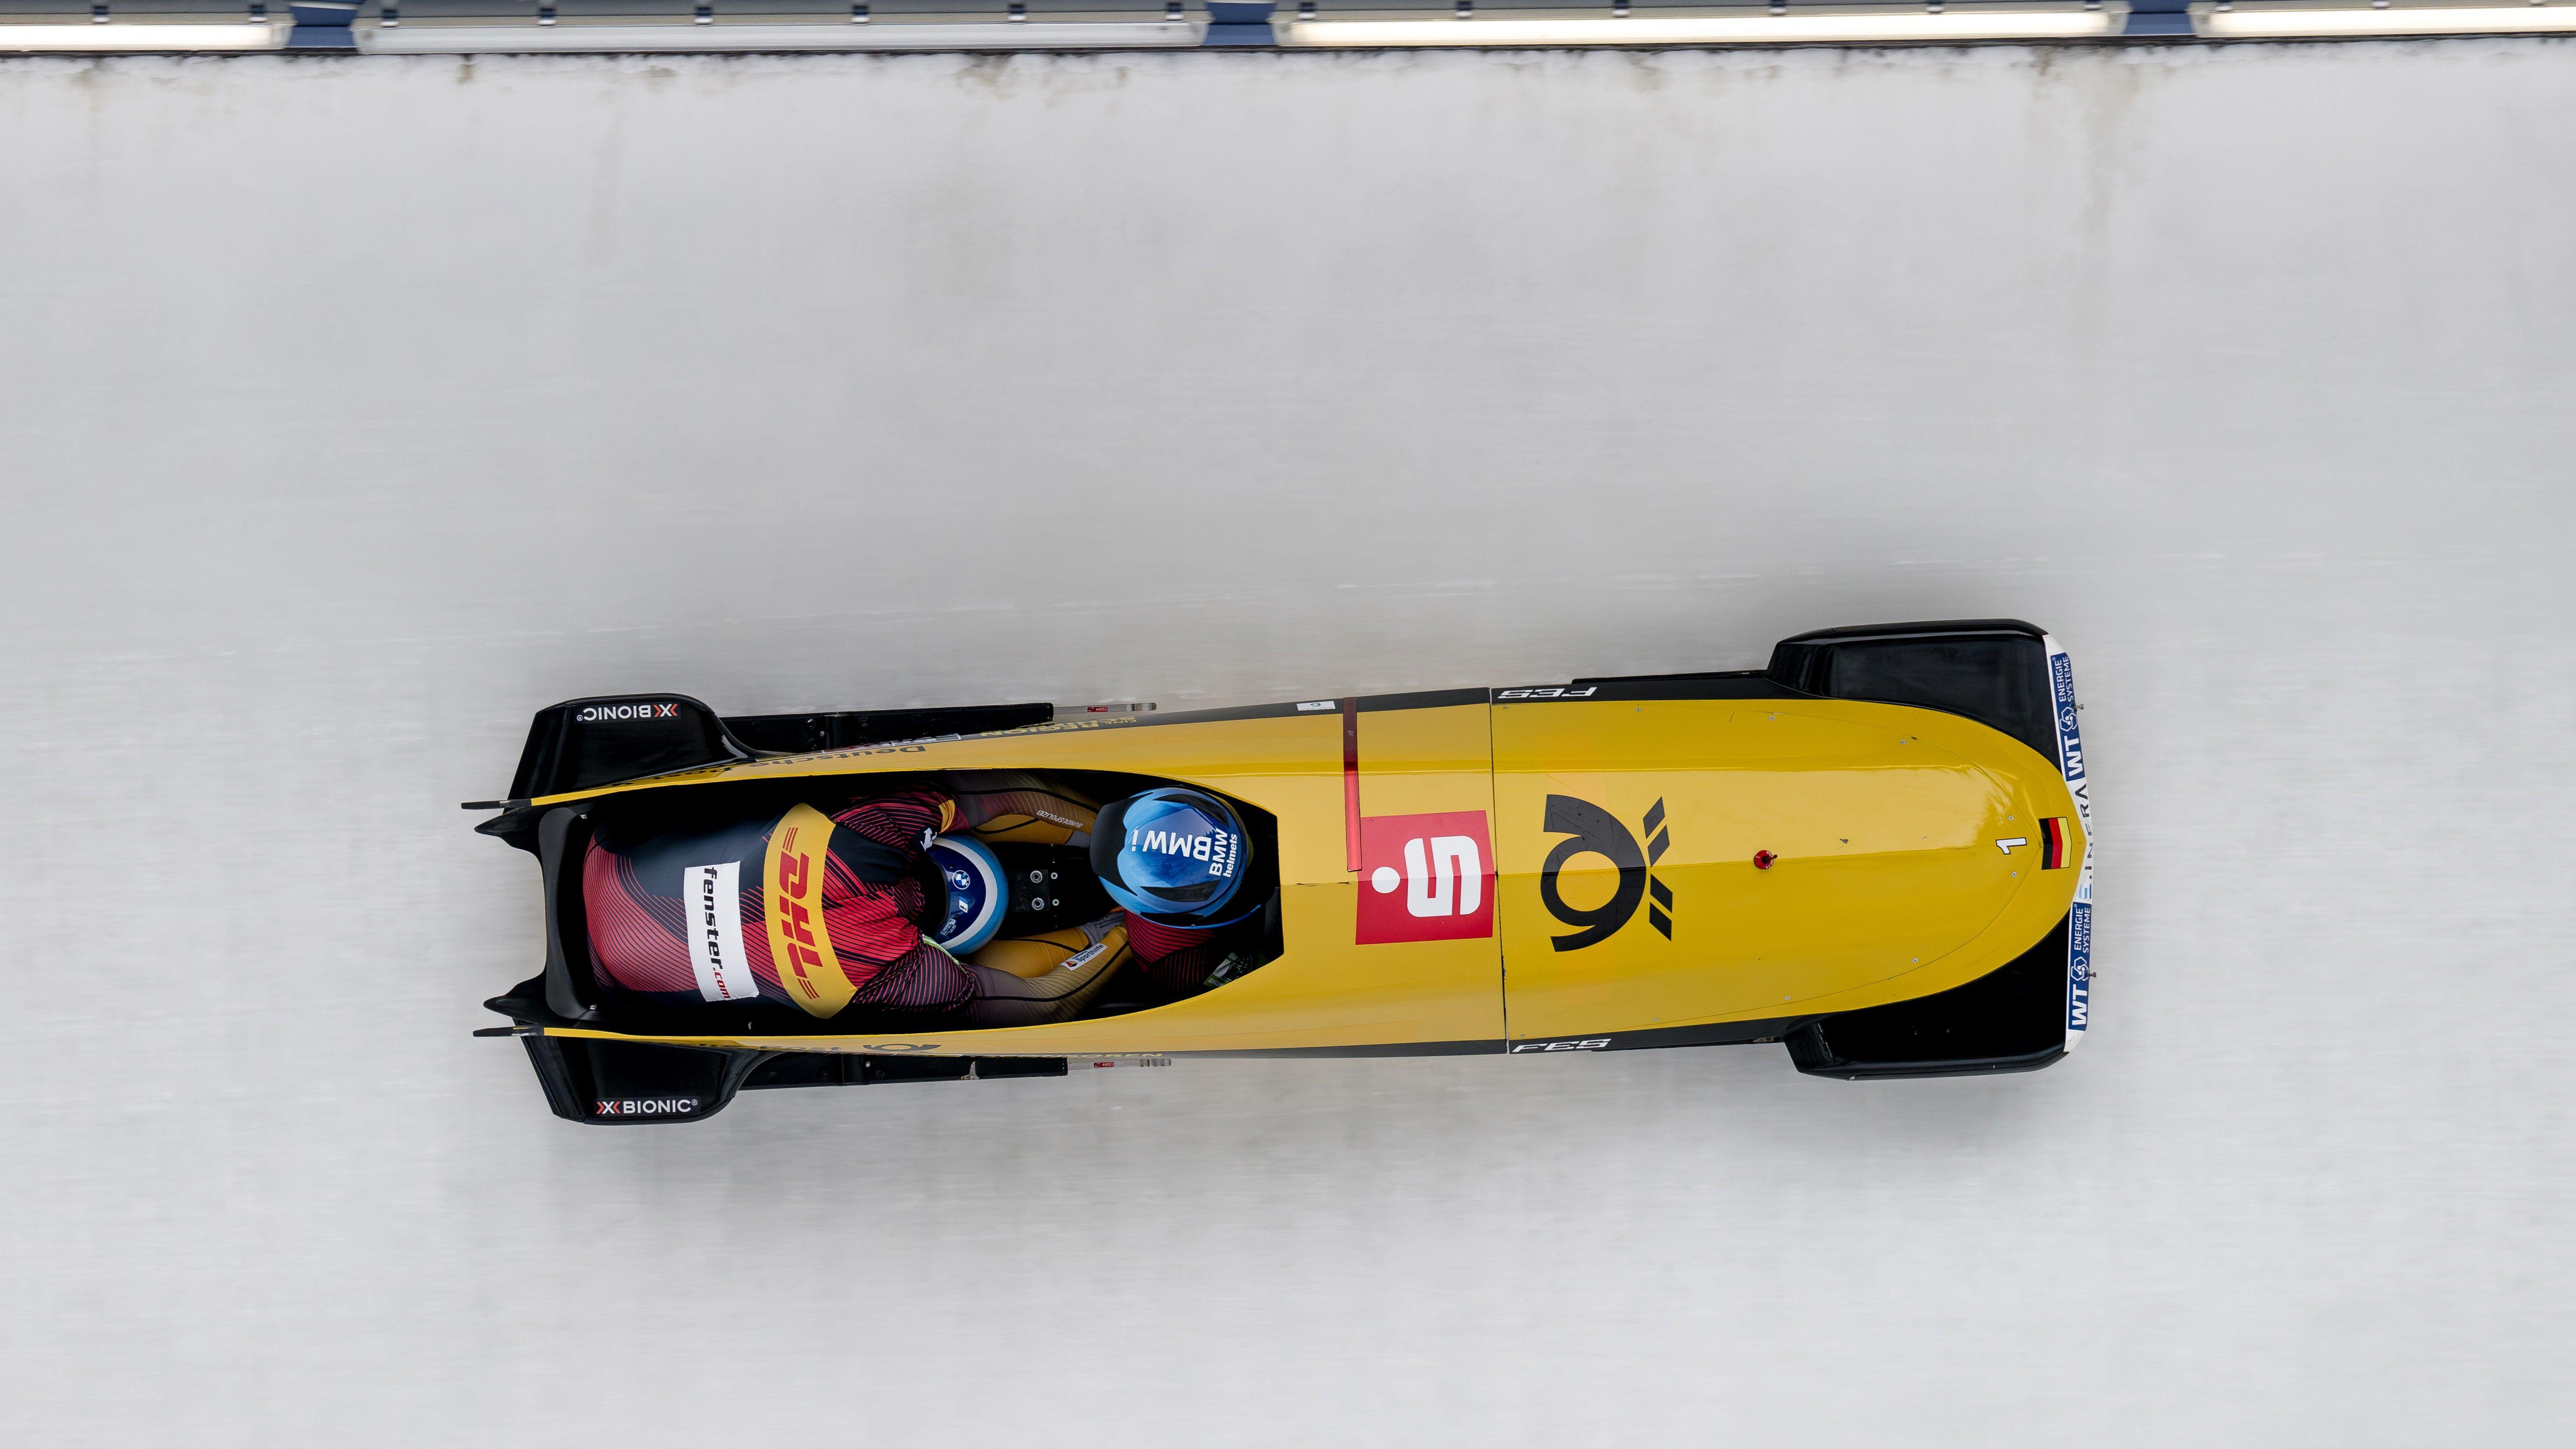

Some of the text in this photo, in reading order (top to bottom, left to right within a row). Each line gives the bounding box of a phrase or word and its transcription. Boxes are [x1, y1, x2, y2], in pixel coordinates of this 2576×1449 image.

[1498, 687, 1597, 698] FES
[2054, 659, 2067, 703] ENERGIE
[2062, 656, 2075, 702] SYSTEME
[749, 745, 927, 767] Deutsche
[2064, 735, 2083, 777] WT
[1142, 830, 1211, 861] BMW
[1209, 828, 1228, 876] BMW
[1223, 833, 1237, 878] helmets
[1996, 837, 2027, 854] 1
[704, 867, 731, 999] fenster.com
[779, 850, 823, 979] DHL
[2074, 907, 2083, 951] ENERGIE
[2083, 907, 2091, 953] SYSTEME
[2072, 984, 2087, 1026] WT
[1512, 1038, 1611, 1052] FES
